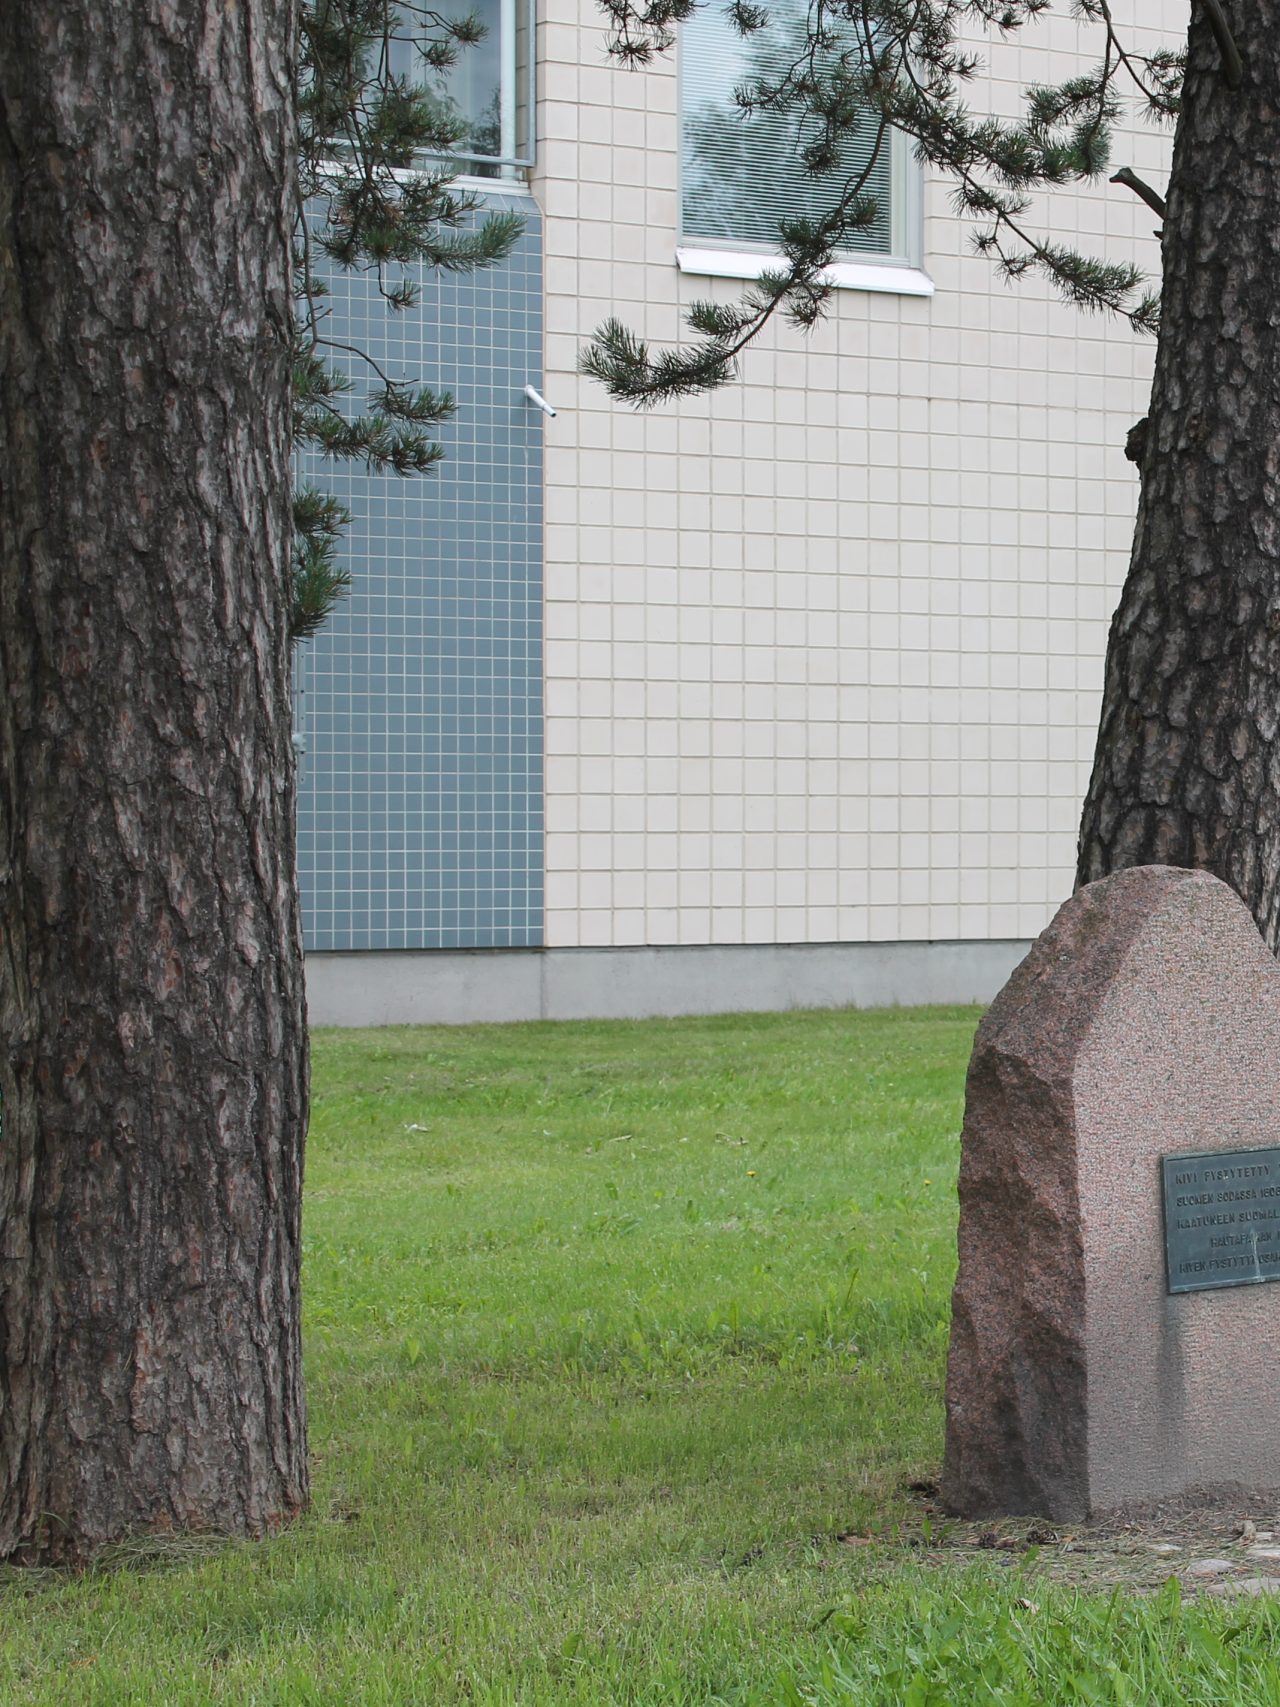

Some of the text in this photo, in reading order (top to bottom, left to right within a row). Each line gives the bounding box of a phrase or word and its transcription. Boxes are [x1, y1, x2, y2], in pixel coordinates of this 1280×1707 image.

[1175, 1172, 1197, 1184] KIVI
[1204, 1165, 1270, 1181] PYSTYTETTY
[1176, 1193, 1214, 1207] SUOMEN
[1217, 1189, 1257, 1202] SODASSA
[1177, 1213, 1235, 1229] KAATUNEEN
[1179, 1261, 1206, 1274] KIVEN
